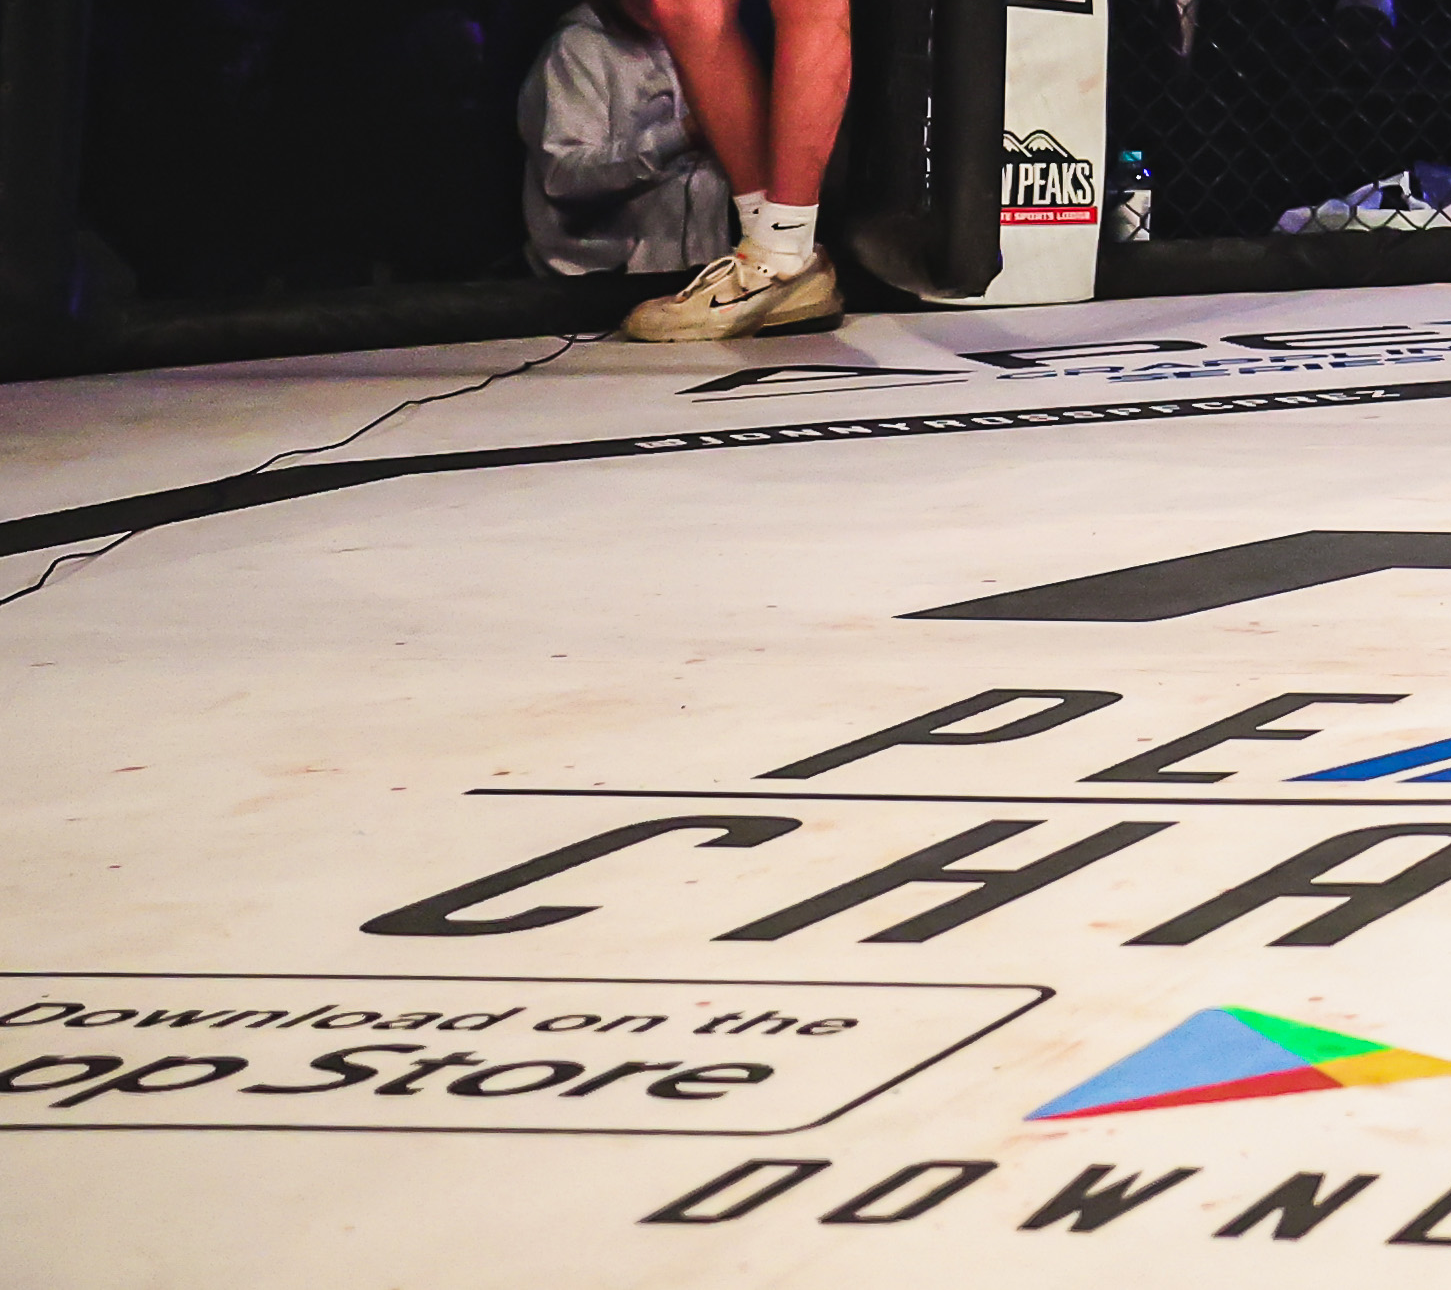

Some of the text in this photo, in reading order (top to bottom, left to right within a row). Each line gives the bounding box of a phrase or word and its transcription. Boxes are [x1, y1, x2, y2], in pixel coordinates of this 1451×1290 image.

[1016, 162, 1092, 206] PEAKS
[1, 1001, 860, 1037] Download on the
[240, 1044, 776, 1100] Store
